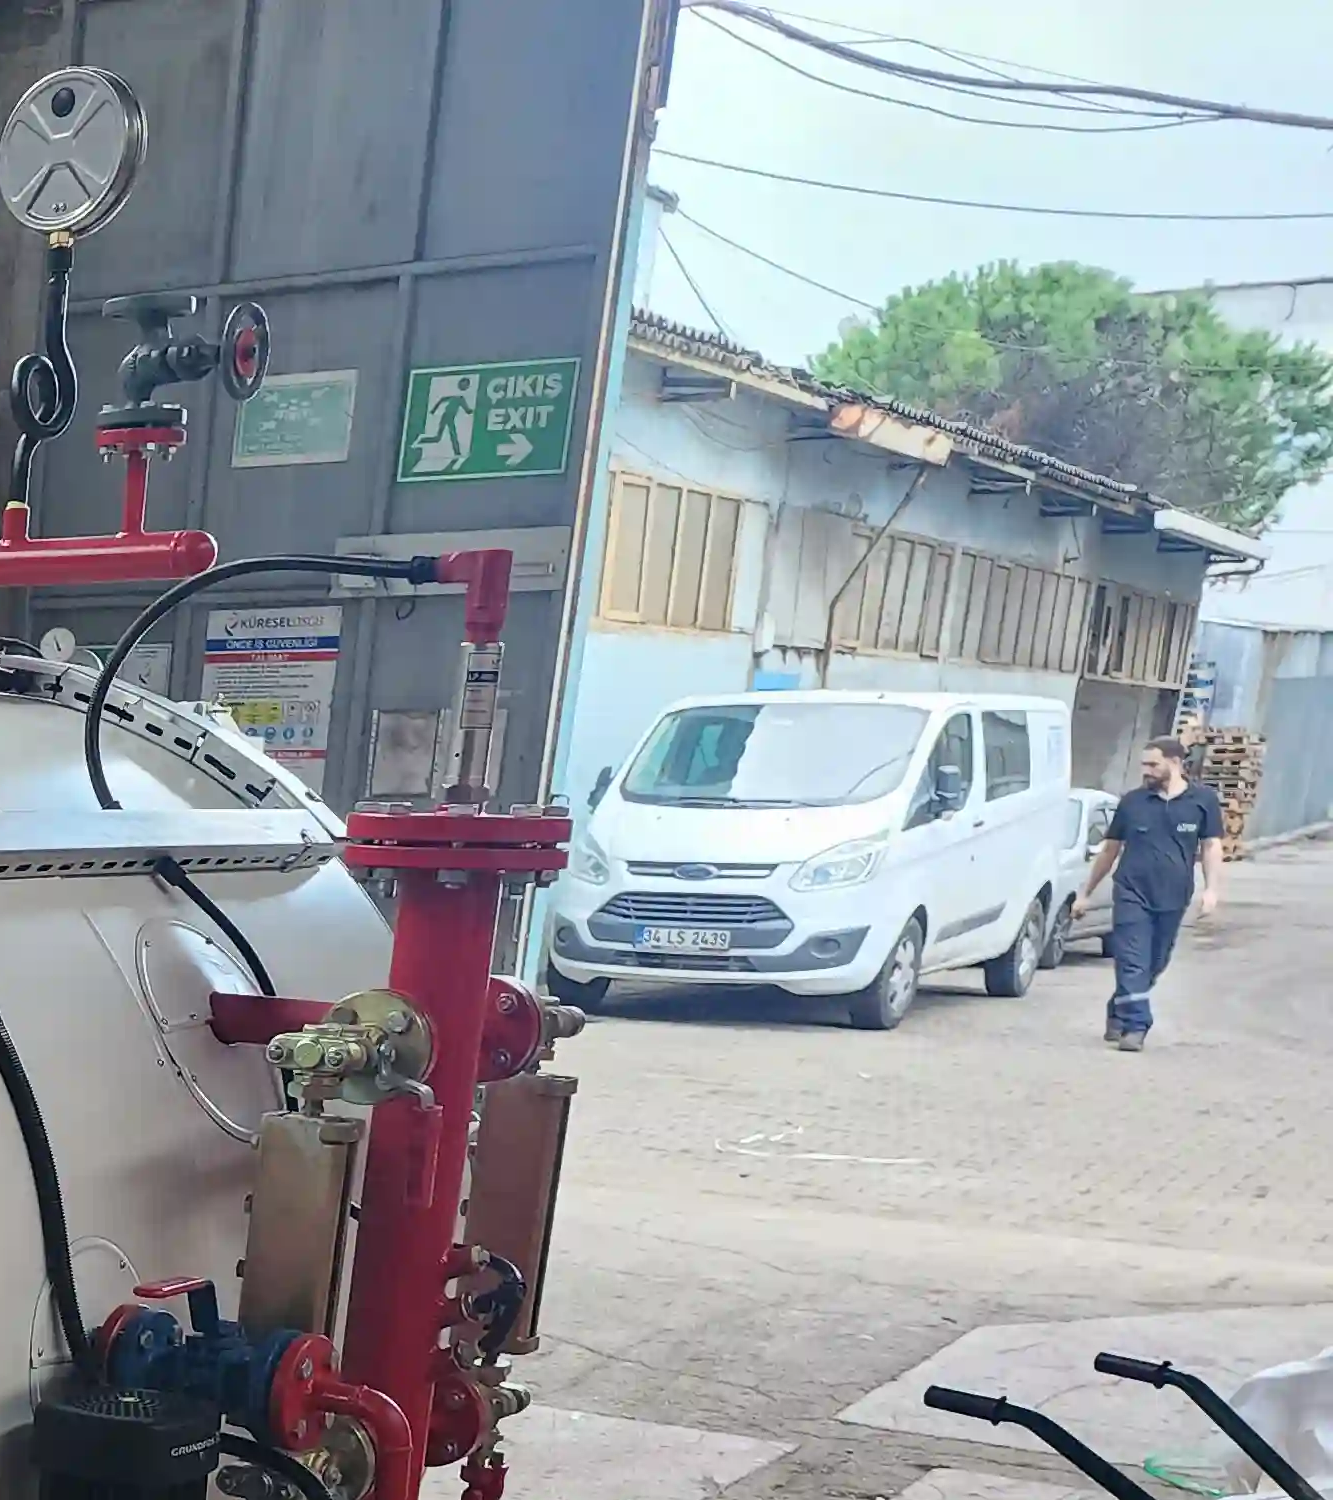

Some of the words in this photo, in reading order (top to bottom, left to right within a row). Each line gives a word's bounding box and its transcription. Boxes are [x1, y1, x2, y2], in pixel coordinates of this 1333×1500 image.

[486, 405, 555, 431] EXIT
[643, 929, 661, 943] 34
[666, 930, 686, 945] LS
[691, 931, 728, 947] 2439
